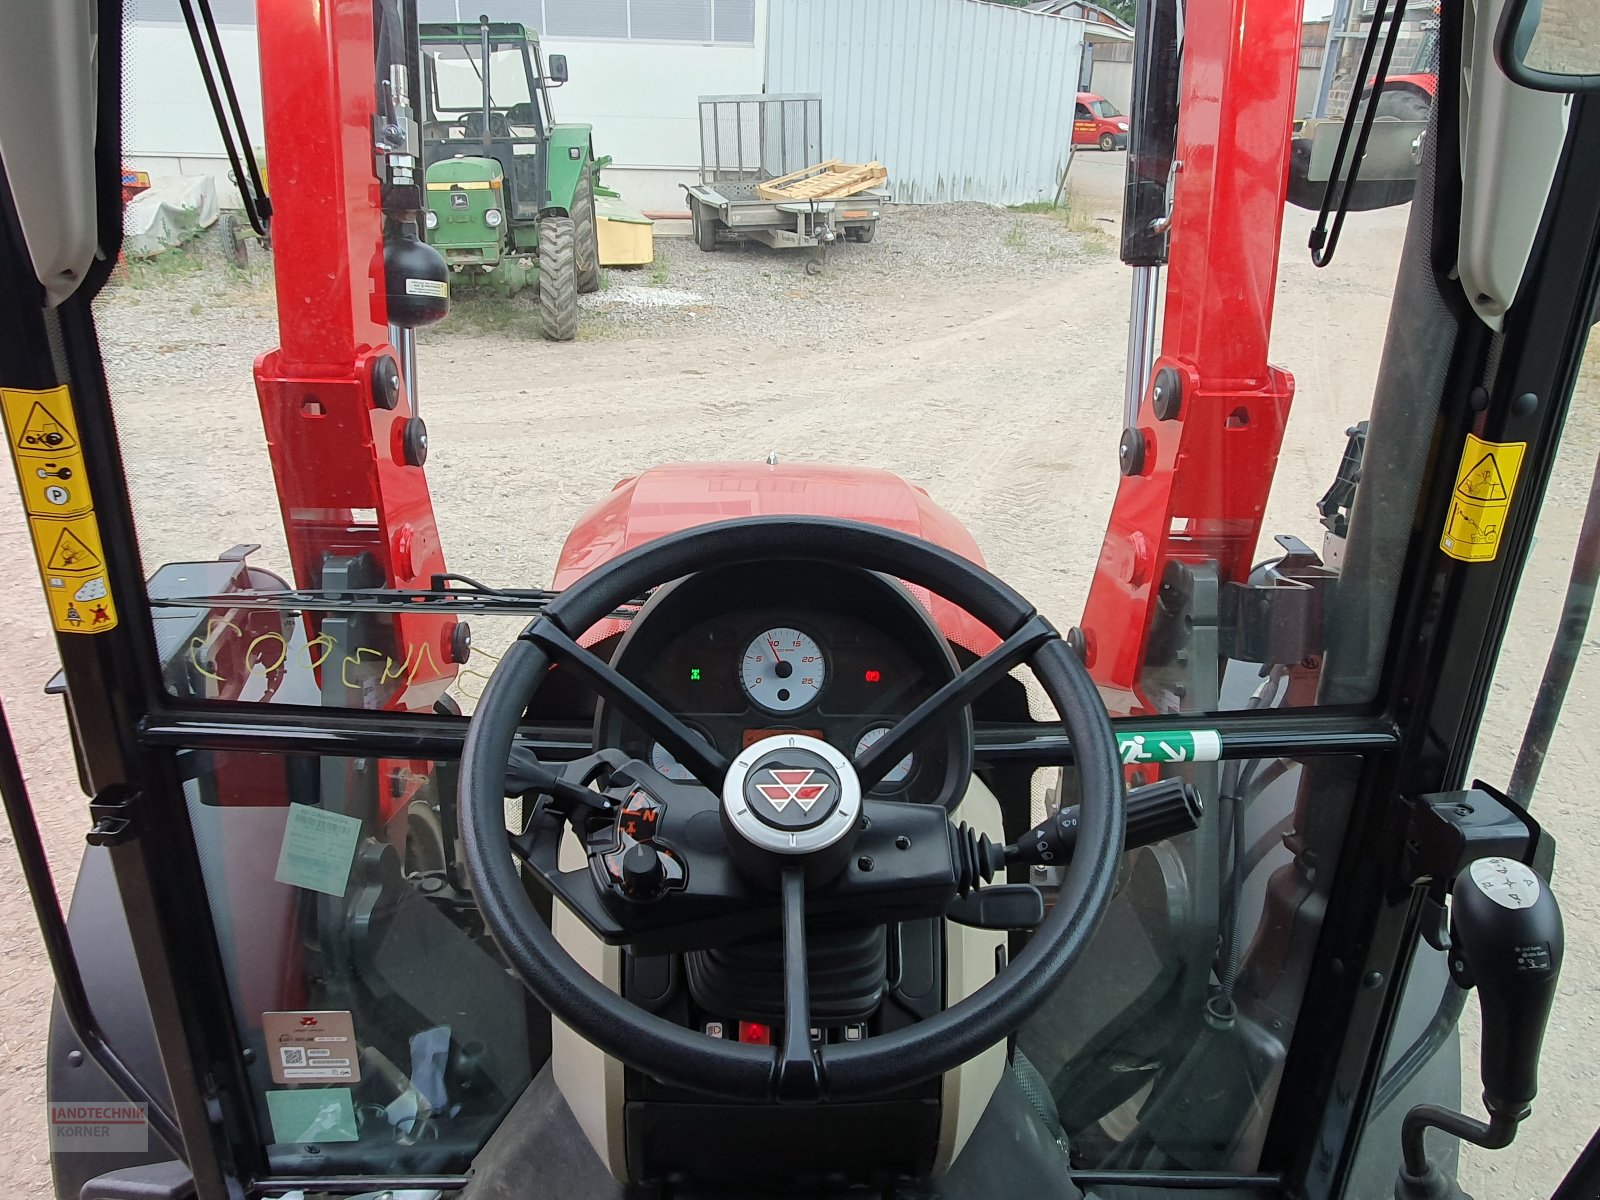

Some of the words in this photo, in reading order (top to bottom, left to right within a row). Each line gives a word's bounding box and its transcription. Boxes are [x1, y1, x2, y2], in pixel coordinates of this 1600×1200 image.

[52, 489, 62, 501] P
[791, 640, 801, 648] 15
[755, 655, 763, 663] 5
[801, 677, 814, 685] 25
[642, 810, 657, 822] N
